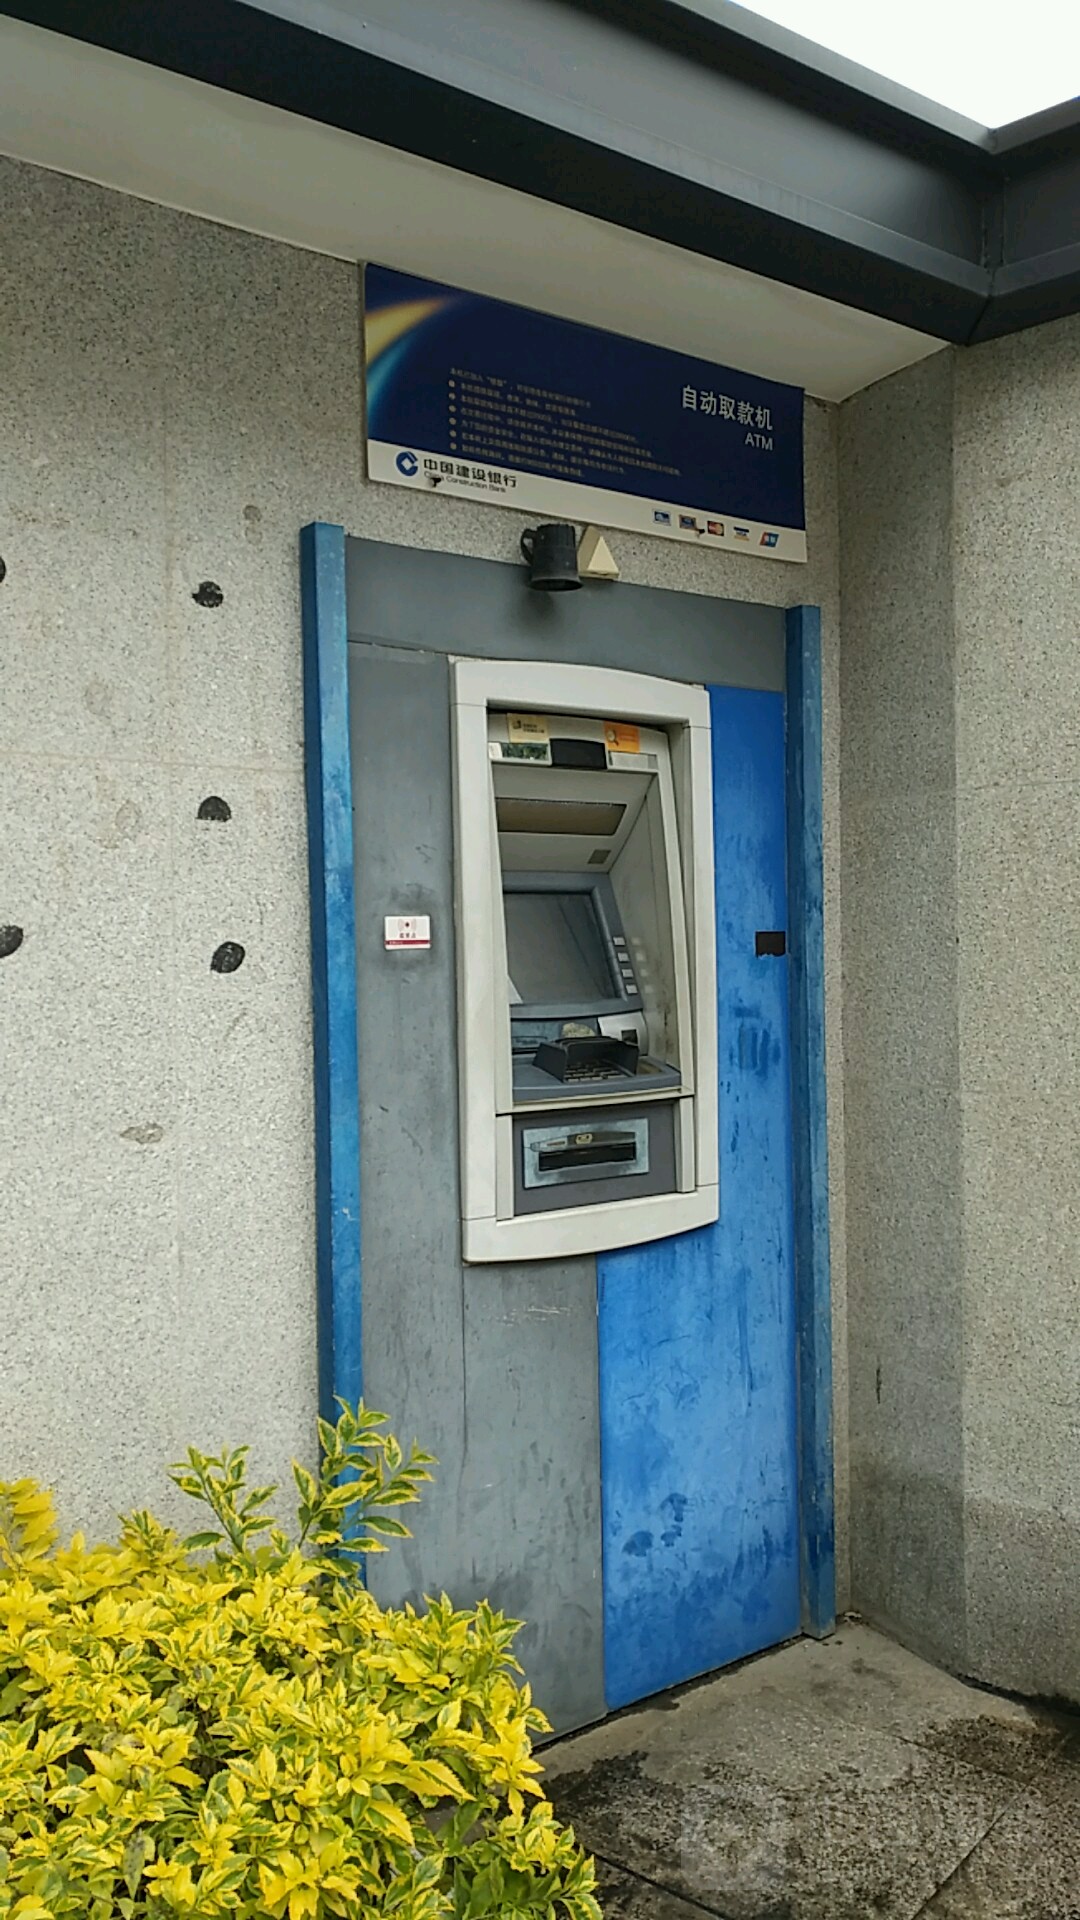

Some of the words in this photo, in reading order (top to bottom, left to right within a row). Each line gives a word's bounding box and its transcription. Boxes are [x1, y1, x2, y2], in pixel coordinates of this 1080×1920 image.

[682, 384, 773, 430] 自动取款机
[745, 432, 773, 451] ATM
[424, 459, 517, 488] 中国建设银行
